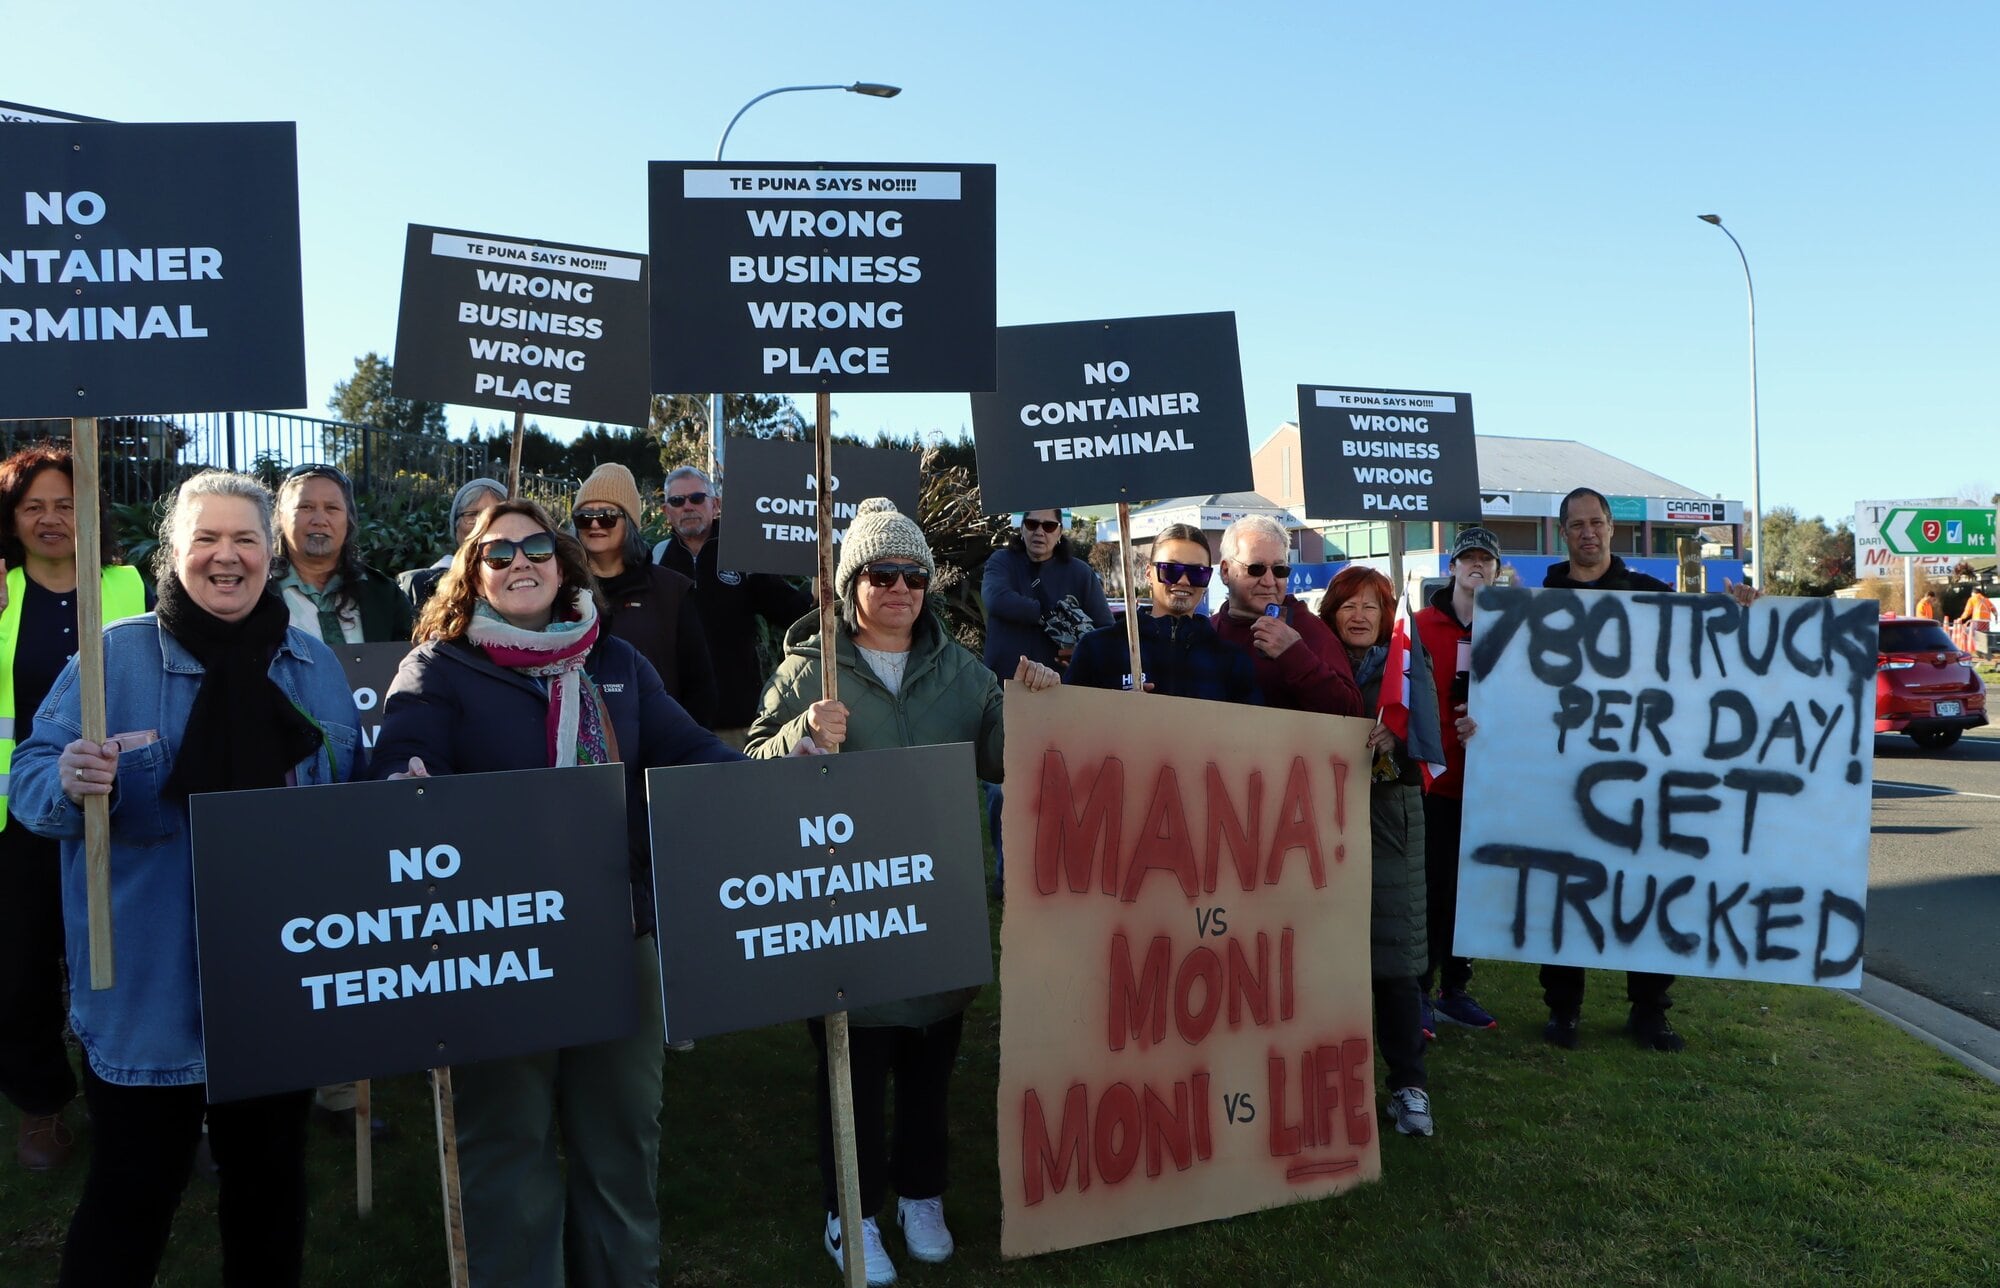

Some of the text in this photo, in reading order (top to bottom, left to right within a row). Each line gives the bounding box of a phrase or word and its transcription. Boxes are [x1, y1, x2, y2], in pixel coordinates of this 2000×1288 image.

[730, 178, 917, 191] TE PUNA SAYS NO!!!!
[26, 191, 106, 226] NO
[747, 211, 903, 238] WRONG
[0, 247, 223, 283] NTAINER
[467, 244, 607, 271] TE PUNA SAYS NO!!!!
[730, 256, 921, 284] BUSINESS
[477, 269, 594, 304] WRONG
[0, 305, 208, 343] RMINAL
[459, 302, 603, 340] BUSINESS
[748, 302, 903, 329] WRONG
[469, 338, 586, 372] WRONG
[764, 347, 890, 375] PLACE
[475, 373, 572, 405] PLACE
[1084, 361, 1130, 384] NO
[1021, 393, 1200, 426] CONTAINER
[1354, 396, 1380, 405] PUNA
[1383, 398, 1407, 406] SAYS
[1349, 415, 1429, 433] WRONG
[1034, 429, 1195, 462] TERMINAL
[1343, 441, 1440, 460] BUSINESS
[1353, 467, 1433, 485] WRONG
[1363, 494, 1428, 511] PLACE
[1667, 501, 1711, 512] CANAM
[1927, 523, 1936, 537] 2
[1968, 534, 1985, 546] Mt
[1471, 586, 1631, 687] 780
[1553, 682, 1863, 785] PER DAY!
[1034, 749, 1347, 902] MANA!
[1574, 760, 1805, 859] GET
[800, 814, 854, 847] NO
[390, 845, 461, 883] NO
[720, 854, 935, 910] CONTAINER
[281, 890, 565, 953] CONTAINER
[1195, 907, 1228, 938] VS
[1471, 844, 1866, 981] TRUCKED
[736, 905, 928, 960] TERMINAL
[302, 948, 554, 1010] TERMINAL
[1108, 928, 1295, 1050] MONI
[1023, 1039, 1370, 1206] MONI VS LIFE
